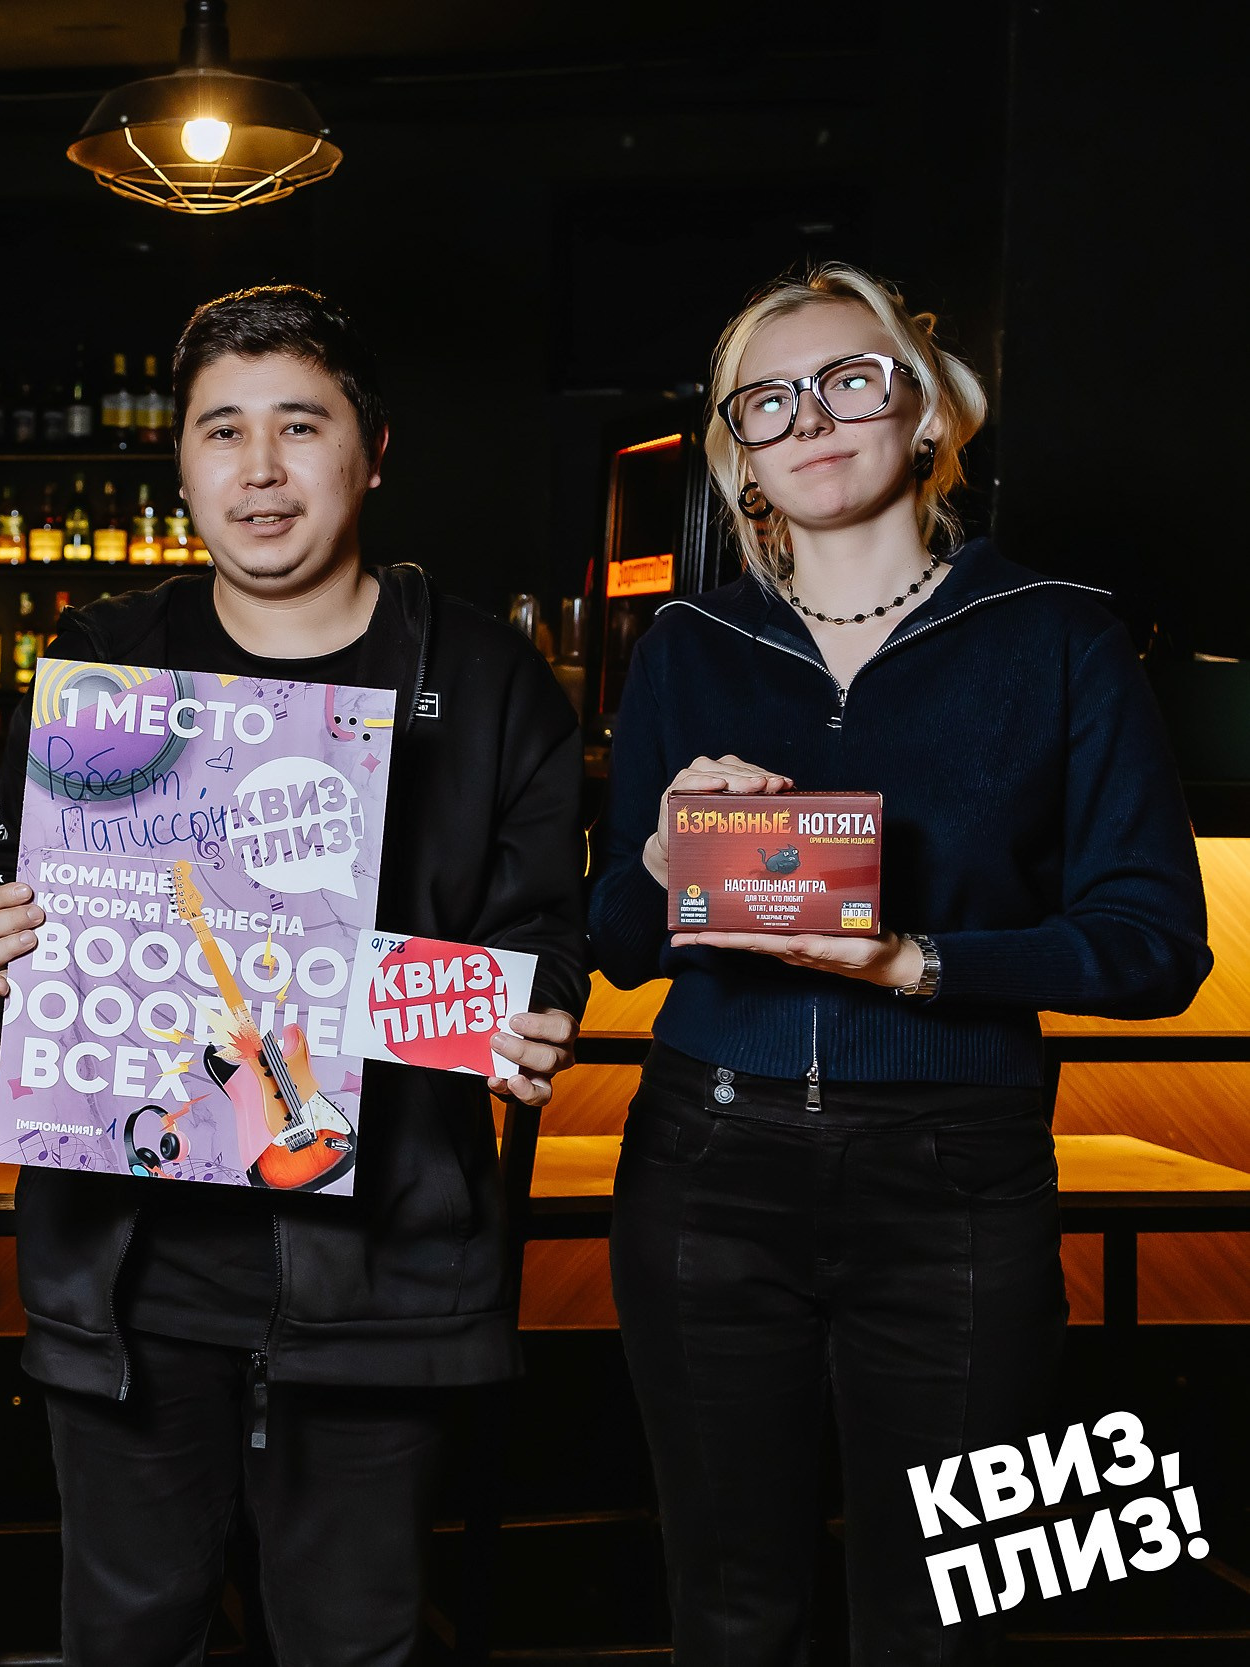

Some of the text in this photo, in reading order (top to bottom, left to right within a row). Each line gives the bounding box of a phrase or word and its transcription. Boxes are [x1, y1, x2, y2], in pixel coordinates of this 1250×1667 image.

[61, 688, 274, 745] 1 МЕСТО
[231, 777, 361, 829] КВИЗ,
[676, 807, 876, 835] ВЗРЫВНЫЕ КОТЯТА
[232, 815, 364, 870] ПЛИЗ!
[809, 836, 876, 845] ОРИГИНАЛЬНОЕ ИЗДАНИЕ
[682, 897, 705, 906] САМЫЙ
[724, 879, 827, 894] НАСТОЛЬНАЯ ИГРА
[783, 895, 804, 903] ЛЮБИТ
[37, 892, 306, 936] КОТОРАЯ РЗНЕСЛА
[374, 953, 506, 1003] КВИЗ,
[373, 994, 510, 1045] ПЛИЗ!
[20, 1036, 195, 1102] ВСЕХ
[16, 1118, 94, 1136] [МЕЛОМАНИЯ]
